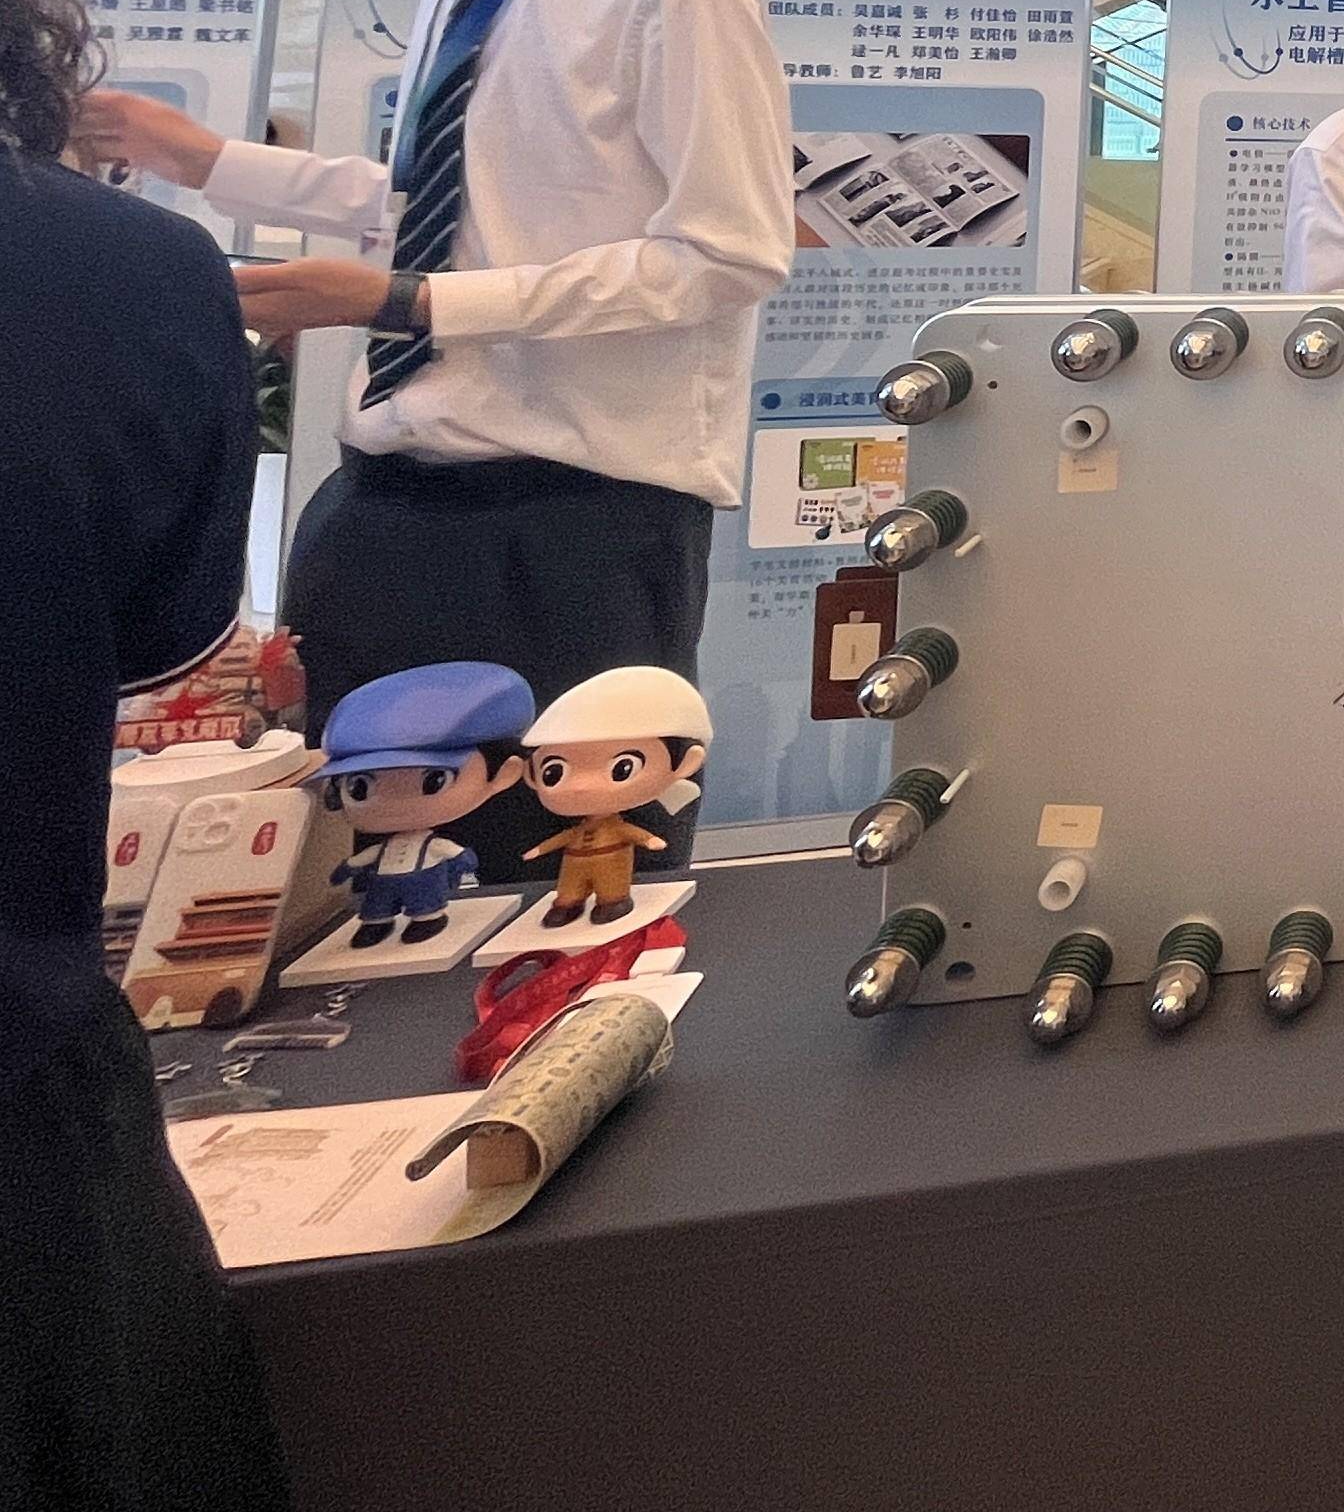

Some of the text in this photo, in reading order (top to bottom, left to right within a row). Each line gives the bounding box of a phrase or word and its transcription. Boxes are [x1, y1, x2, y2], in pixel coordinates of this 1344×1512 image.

[969, 27, 1018, 42] 欧阳伟
[1252, 116, 1312, 132] 核心技术
